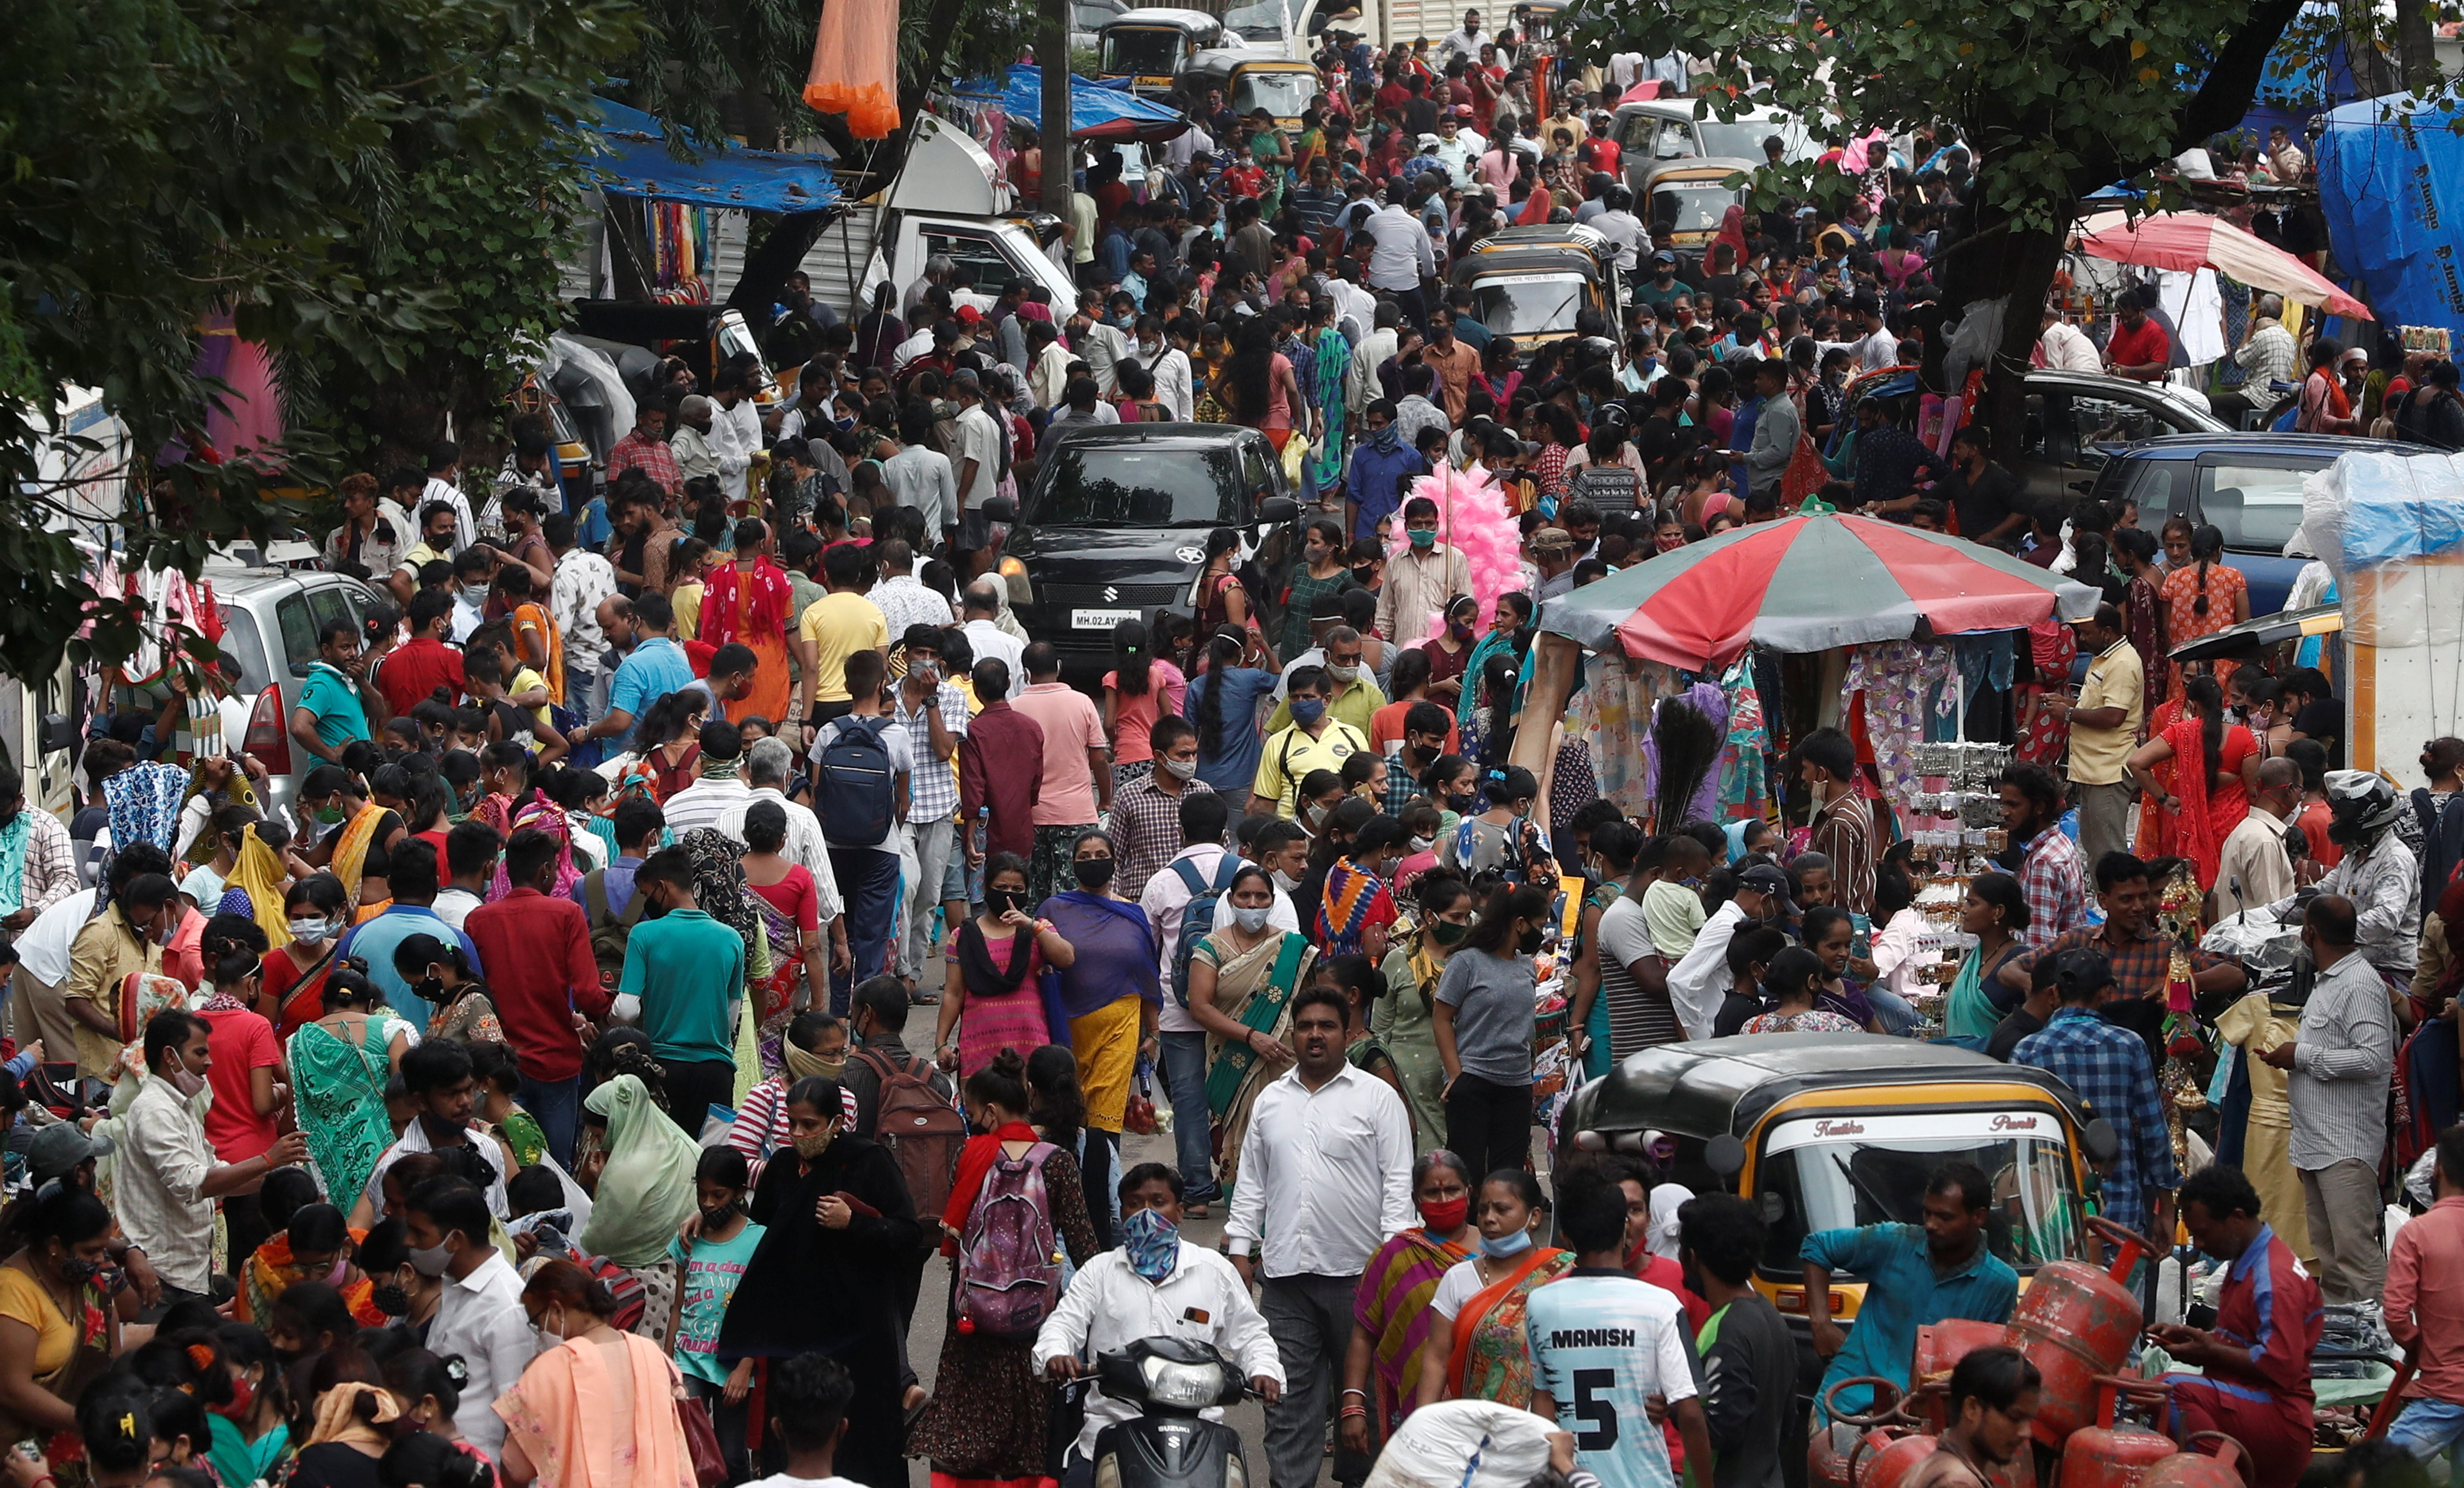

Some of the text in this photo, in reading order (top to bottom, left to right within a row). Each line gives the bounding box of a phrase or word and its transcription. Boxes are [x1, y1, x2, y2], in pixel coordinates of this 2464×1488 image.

[2421, 181, 2440, 230] Jumbo
[2443, 263, 2464, 314] Jumbo
[303, 689, 314, 700] 3
[705, 1262, 716, 1272] a
[704, 1288, 715, 1300] a
[1551, 1329, 1635, 1348] MANISH
[1573, 1368, 1619, 1451] 5
[1158, 1425, 1190, 1434] SUZUKI
